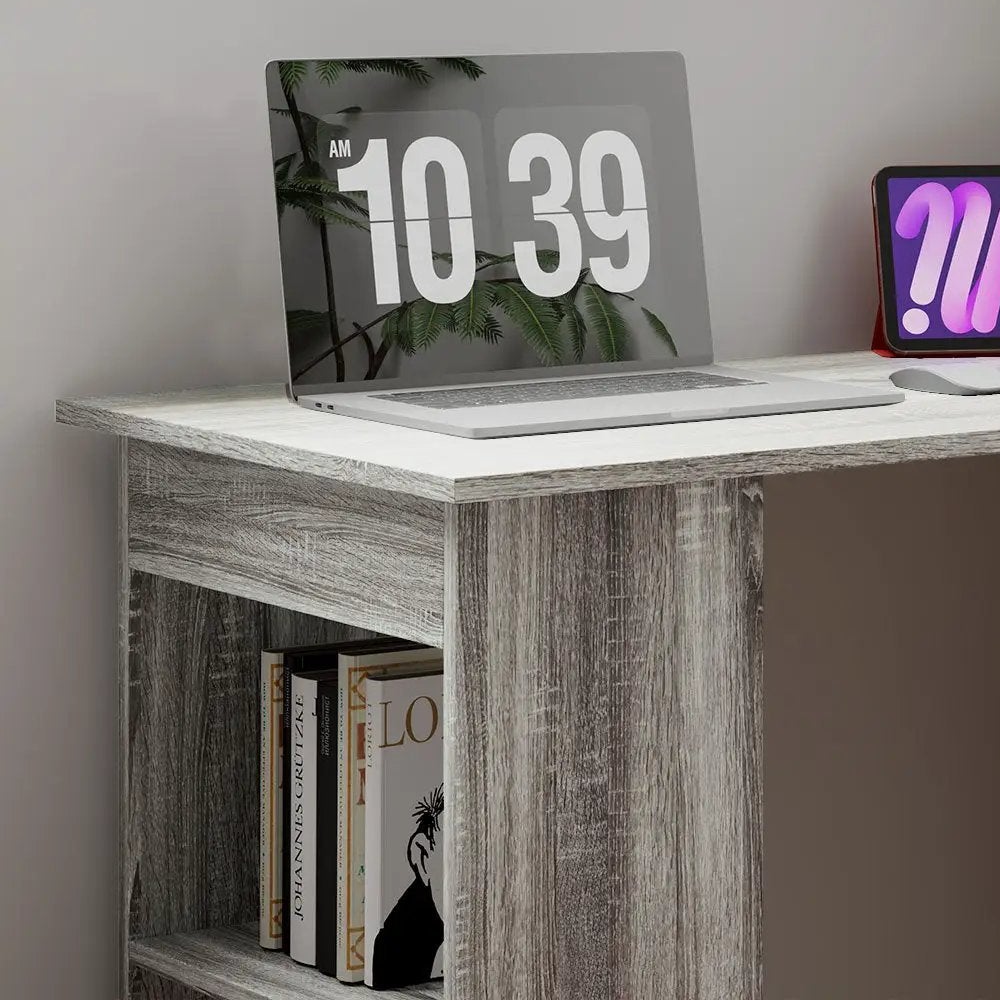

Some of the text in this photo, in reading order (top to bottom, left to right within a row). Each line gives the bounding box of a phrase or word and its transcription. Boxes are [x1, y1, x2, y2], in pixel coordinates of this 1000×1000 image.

[329, 140, 351, 159] AM
[337, 130, 650, 306] 10 39
[379, 695, 443, 748] LO
[294, 694, 304, 921] JOHANNES GRÜTZKE
